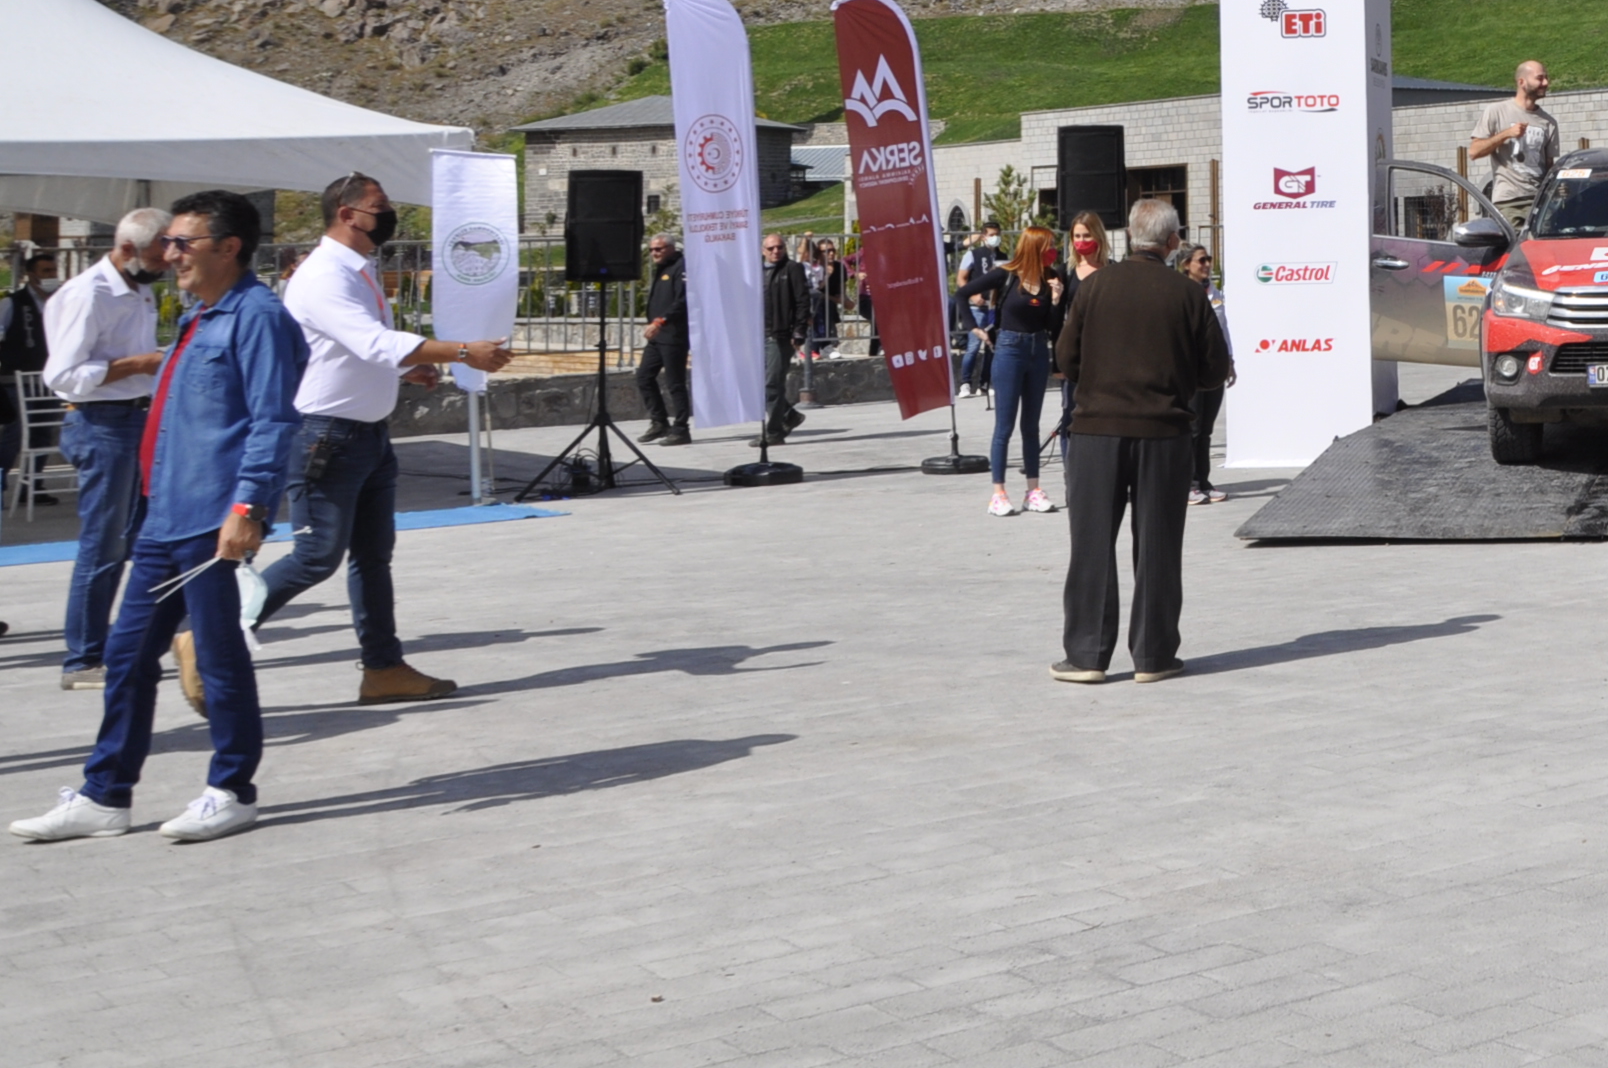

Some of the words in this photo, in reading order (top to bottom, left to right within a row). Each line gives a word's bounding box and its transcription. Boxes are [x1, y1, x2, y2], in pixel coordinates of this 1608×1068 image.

[1561, 169, 1587, 178] 625
[1253, 201, 1309, 210] GENERAL
[1309, 200, 1337, 209] TIRE
[1274, 265, 1331, 282] Castrol
[1452, 303, 1480, 339] 62
[1277, 338, 1334, 352] ANLAS
